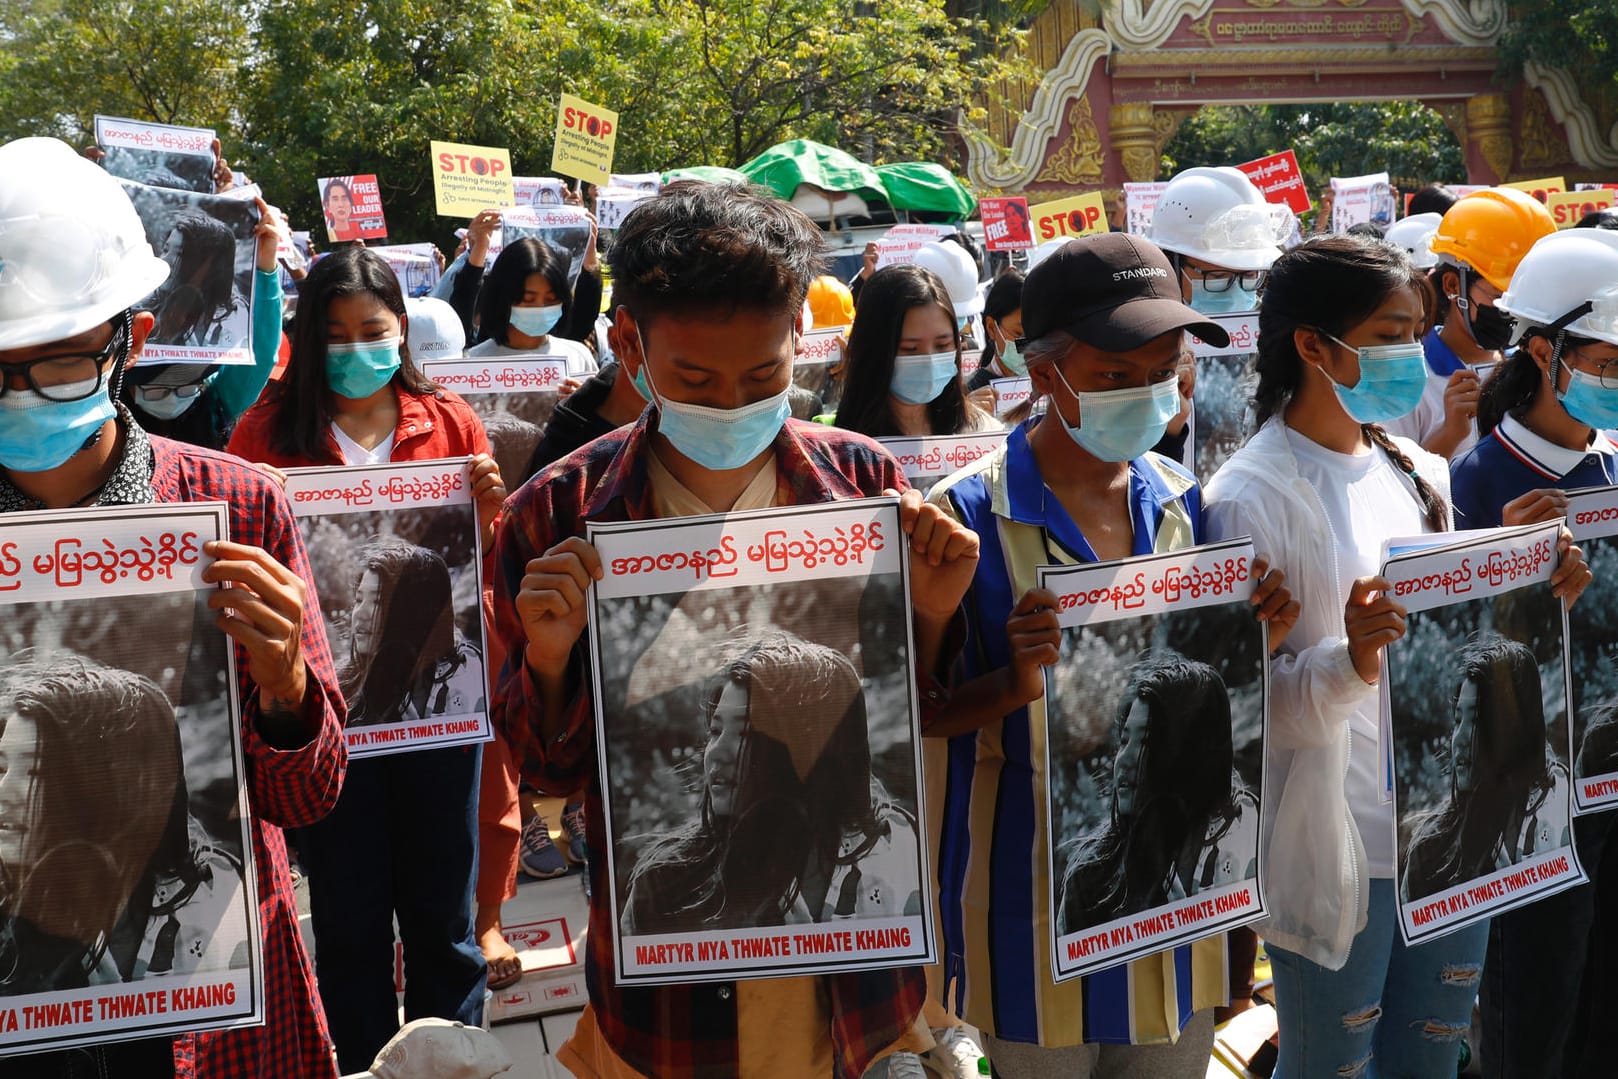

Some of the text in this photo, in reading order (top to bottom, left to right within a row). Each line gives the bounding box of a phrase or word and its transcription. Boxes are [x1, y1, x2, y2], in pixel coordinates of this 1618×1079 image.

[564, 107, 612, 140] STOP
[439, 153, 505, 177] STOP
[352, 182, 377, 194] FREE
[441, 174, 479, 185] Arresting
[480, 177, 507, 187] People
[352, 204, 381, 214] LEADER
[363, 195, 379, 204] OUR
[986, 219, 1009, 241] FREE
[1039, 207, 1100, 239] STOP
[1112, 267, 1168, 281] STANDARD
[294, 479, 373, 505] အာဇာနည်
[611, 536, 738, 579] အာဇာနည်
[1059, 572, 1145, 610] အာဇာနည်
[1394, 558, 1472, 596] အာဇာနည်
[348, 733, 368, 746] MYA
[369, 728, 406, 743] THWATE
[407, 723, 443, 739] THWATE
[445, 719, 480, 734] KHAING
[1411, 855, 1569, 927] MARTYR MYA THWATE THWATE KHAING
[1067, 889, 1250, 961] MARTYR MYA THWATE THWATE KHAING
[636, 927, 911, 966] MARTYR MYA THWATE THWATE KHAING
[0, 982, 236, 1034] YA THWATE THWATE KHAING
